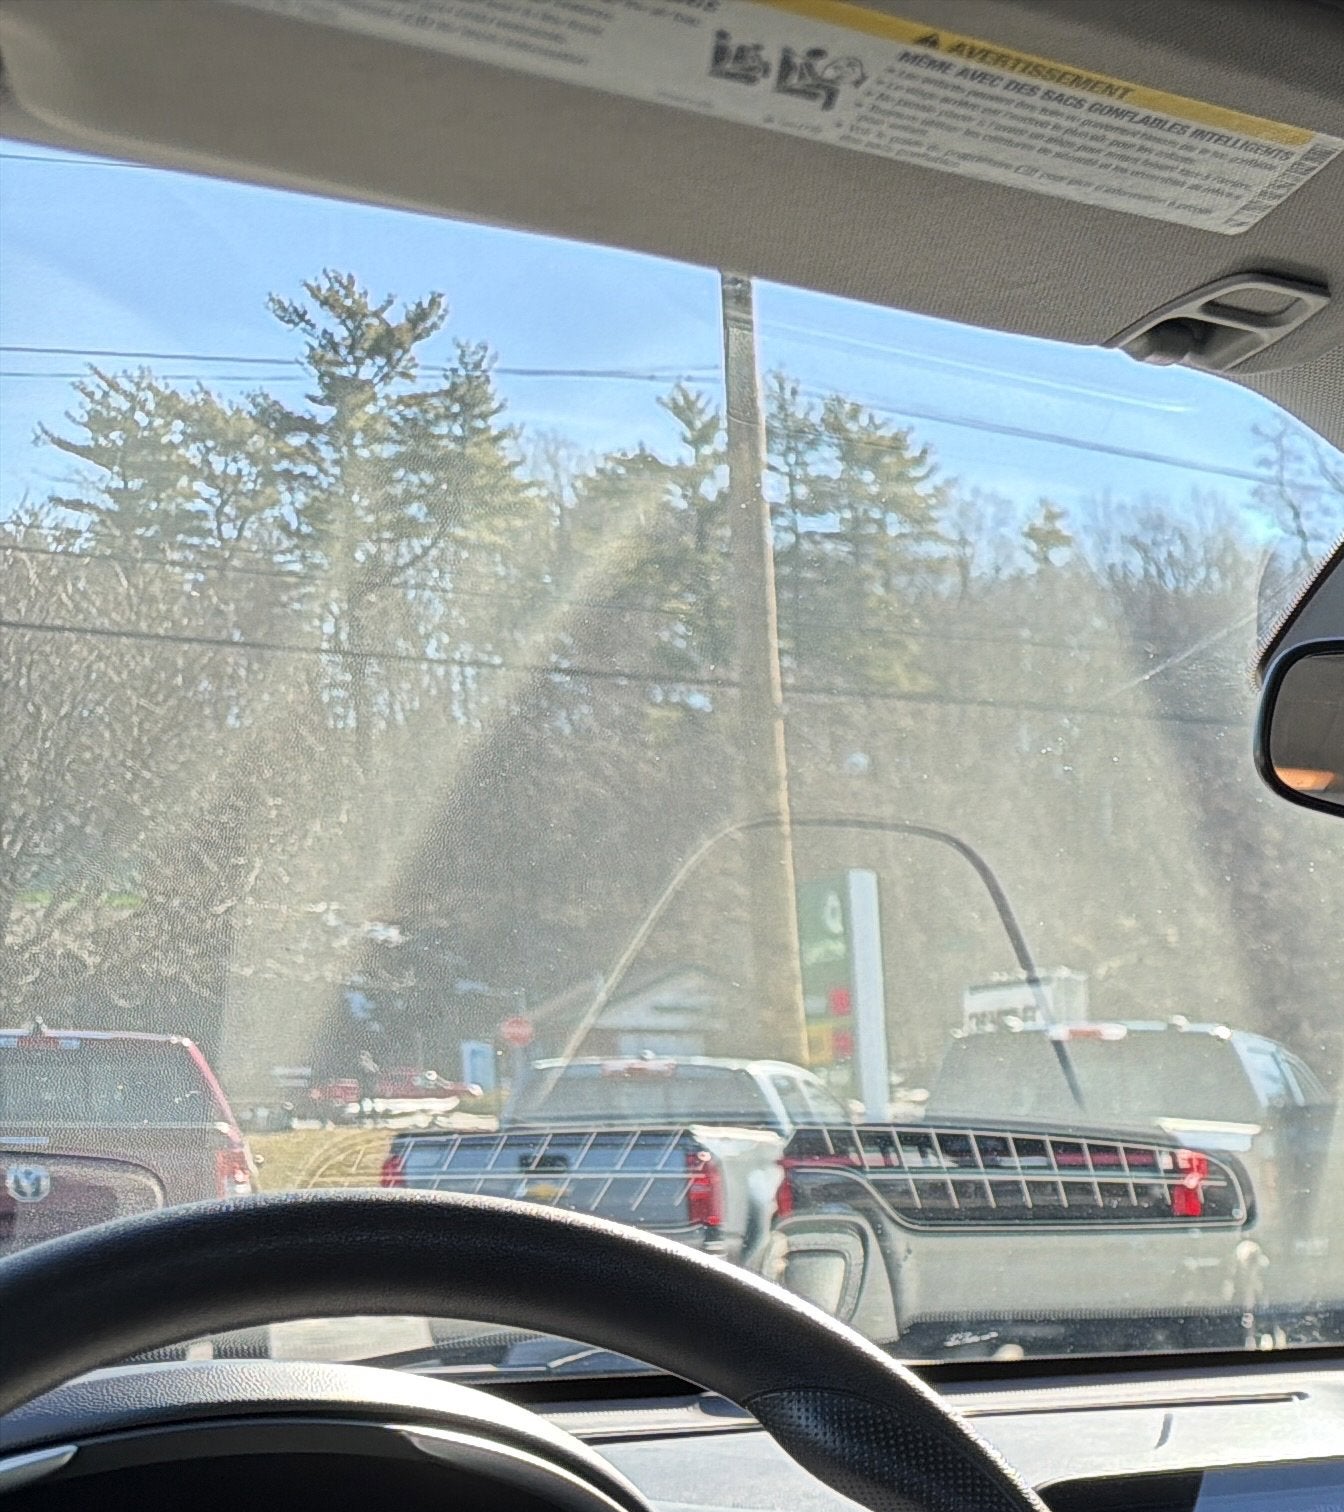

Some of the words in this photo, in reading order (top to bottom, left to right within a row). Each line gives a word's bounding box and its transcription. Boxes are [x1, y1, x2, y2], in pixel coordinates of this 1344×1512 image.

[950, 41, 1134, 100] AVERTISSEMENT
[957, 66, 1004, 88] AVEC
[1003, 79, 1041, 97] DES
[1040, 88, 1088, 110] SACS
[1087, 102, 1192, 136] GONFLABLES
[1190, 128, 1295, 161] INTELLIGENTS
